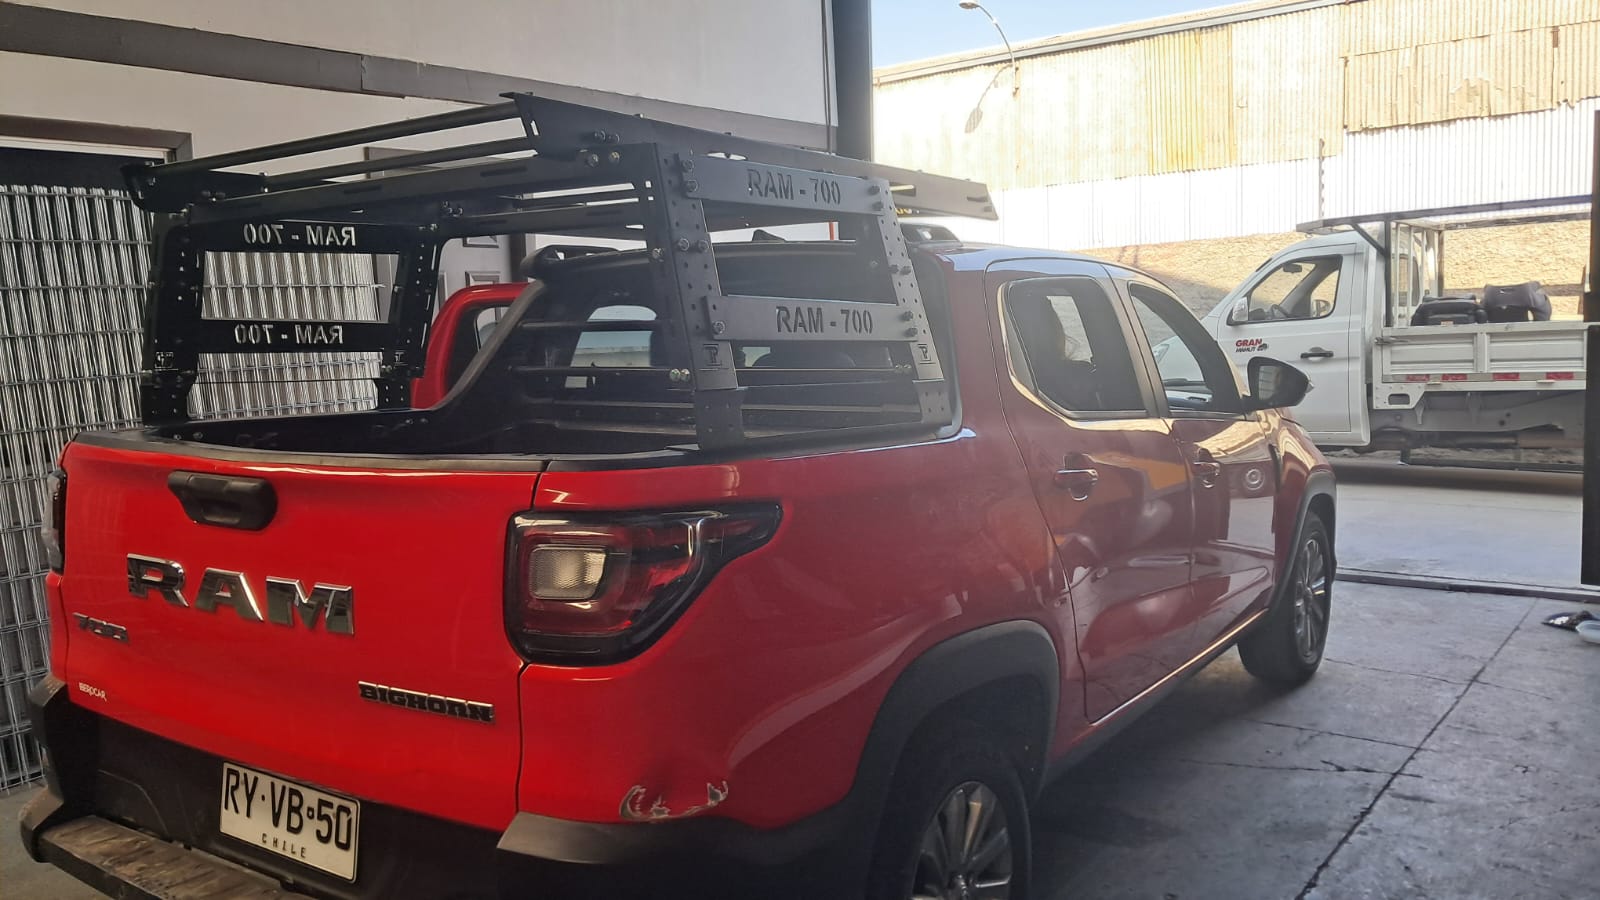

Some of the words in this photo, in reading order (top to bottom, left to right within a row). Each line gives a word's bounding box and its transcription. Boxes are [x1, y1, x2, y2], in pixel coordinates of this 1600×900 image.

[747, 168, 794, 200] RAM
[809, 177, 841, 205] 700
[776, 306, 824, 333] RAM
[840, 308, 873, 334] 700
[1235, 338, 1263, 347] GRAN
[127, 553, 354, 635] RAM
[358, 680, 494, 723] BIGHORN
[261, 832, 307, 859] CHILE
